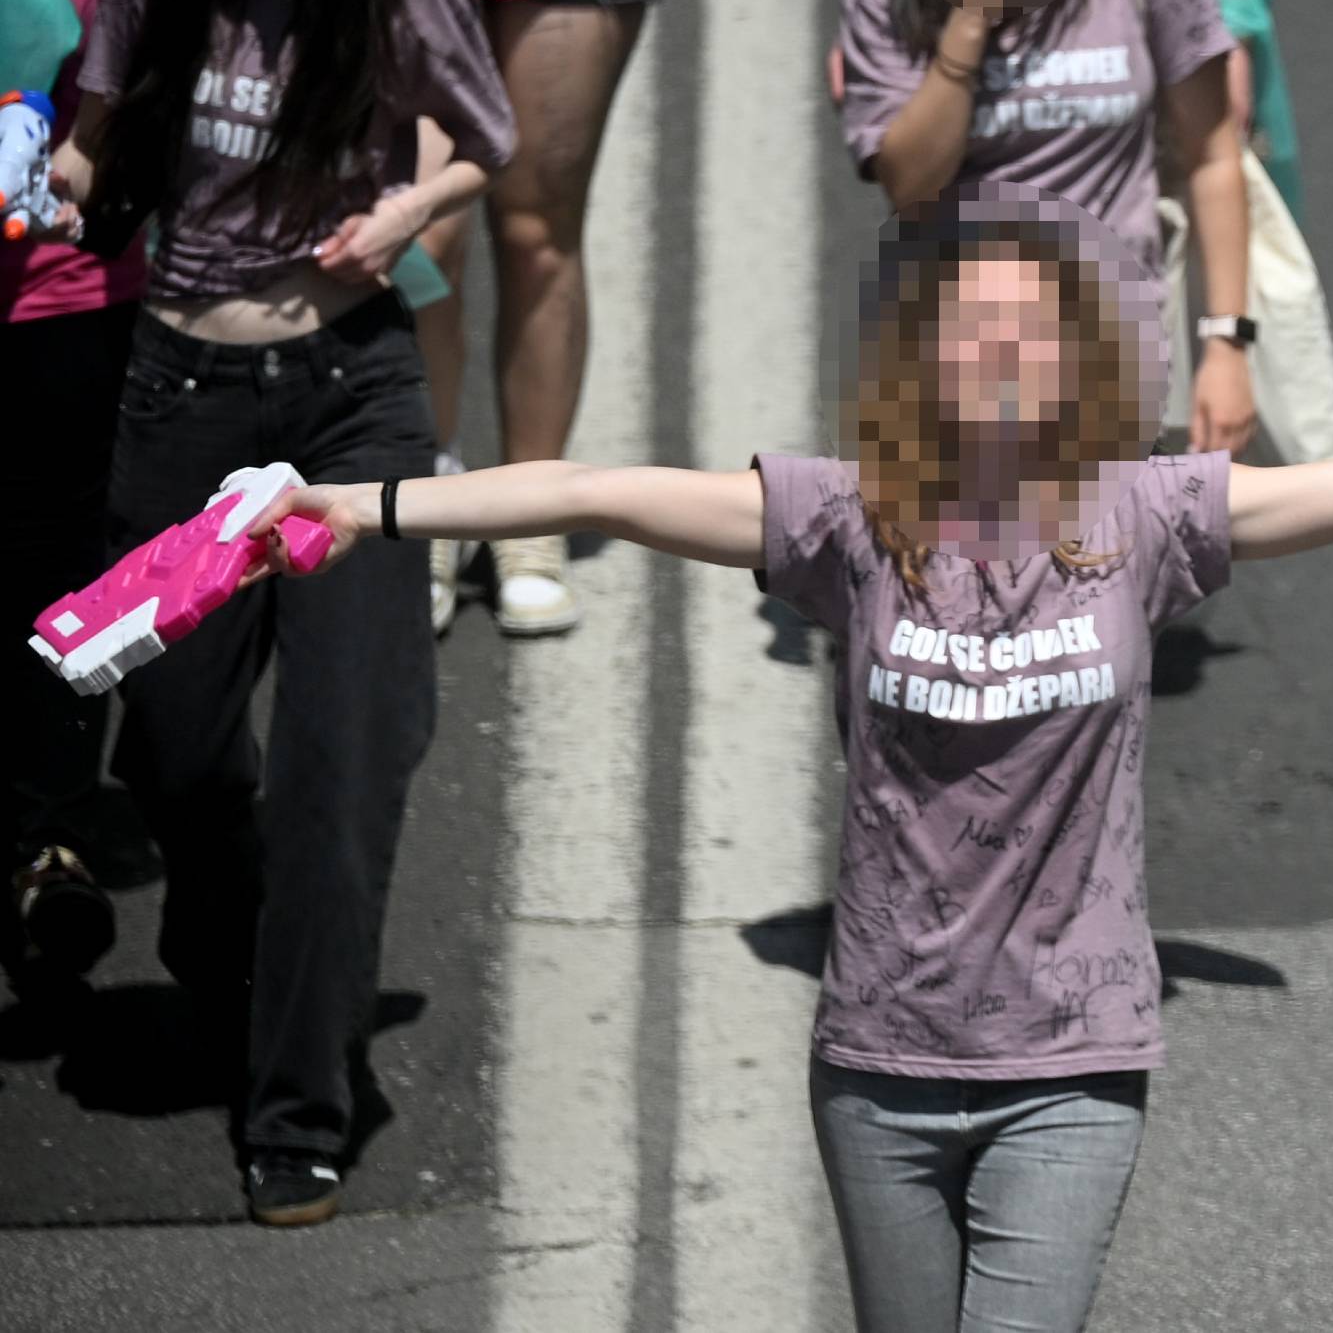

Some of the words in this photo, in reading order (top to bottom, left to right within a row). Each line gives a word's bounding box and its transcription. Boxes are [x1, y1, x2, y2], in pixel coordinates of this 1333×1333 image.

[193, 68, 225, 107] OL
[230, 75, 272, 116] SE
[889, 618, 948, 664] GOL
[947, 633, 986, 673] SE
[868, 664, 903, 709] NE
[904, 673, 977, 721] BOJI
[982, 663, 1117, 721] DŽEPARA
